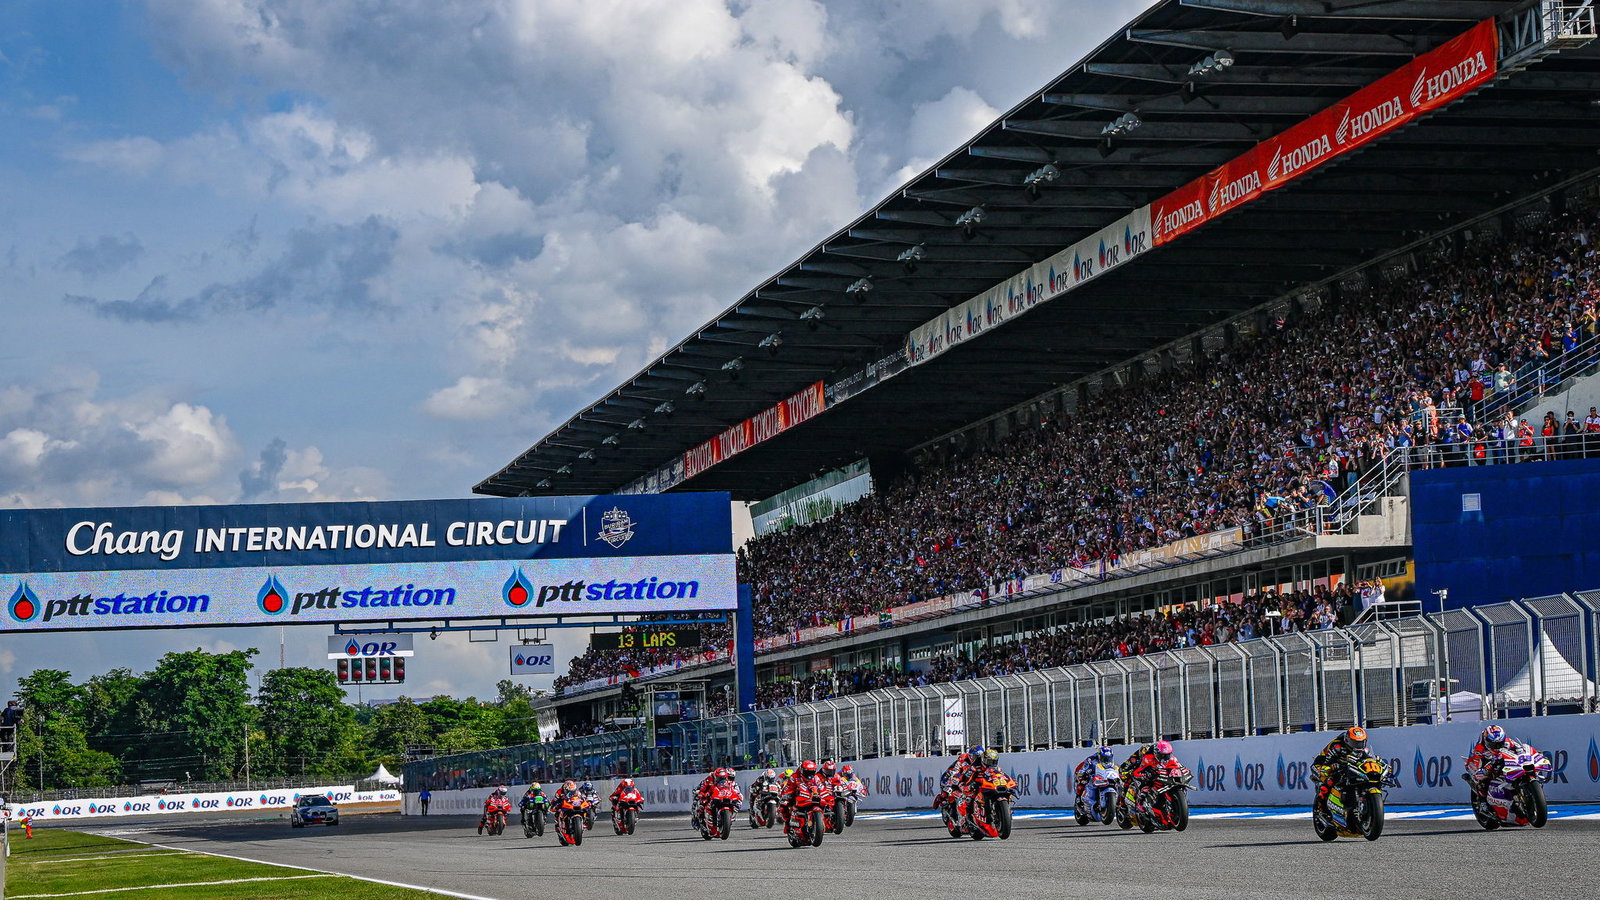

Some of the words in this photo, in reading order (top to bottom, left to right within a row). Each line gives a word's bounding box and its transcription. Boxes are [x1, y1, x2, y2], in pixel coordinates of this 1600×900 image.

[1426, 51, 1488, 100] HONDA
[1350, 96, 1404, 139] HONDA
[1282, 134, 1332, 175] HONDA
[1220, 170, 1262, 206] HONDA
[1164, 200, 1204, 234] HONDA
[1132, 230, 1146, 254] OR
[1106, 244, 1119, 268] OR
[1080, 258, 1093, 280] OR
[1056, 270, 1068, 292] OR
[1014, 292, 1024, 313] OR
[1031, 282, 1044, 304] OR
[972, 314, 982, 334] OR
[992, 304, 1003, 324] OR
[934, 334, 943, 352] OR
[950, 325, 962, 343] OR
[915, 344, 925, 361] OR
[788, 385, 819, 427] TOYOTA
[718, 423, 745, 460] TOYOTA
[64, 520, 184, 560] Chang
[194, 522, 437, 552] INTERNATIONAL
[446, 520, 568, 546] CIRCUIT
[362, 642, 397, 656] OR
[618, 634, 634, 648] 13
[643, 632, 676, 647] LAPS
[525, 654, 552, 666] OR
[1244, 763, 1264, 791] OR
[1286, 761, 1308, 790] OR
[1363, 762, 1378, 772] 10
[1426, 756, 1452, 788] OR
[881, 775, 891, 795] OR
[901, 777, 912, 797] OR
[924, 776, 934, 796] OR
[1017, 772, 1031, 796] OR
[1044, 771, 1058, 796] OR
[1206, 764, 1226, 792] OR
[167, 801, 185, 810] OR
[201, 800, 219, 808] OR
[235, 798, 252, 806] OR
[268, 796, 286, 805] OR
[334, 792, 351, 801] OR
[26, 808, 45, 816] OR
[62, 806, 81, 815] OR
[98, 805, 116, 813] OR
[132, 803, 150, 812] OR
